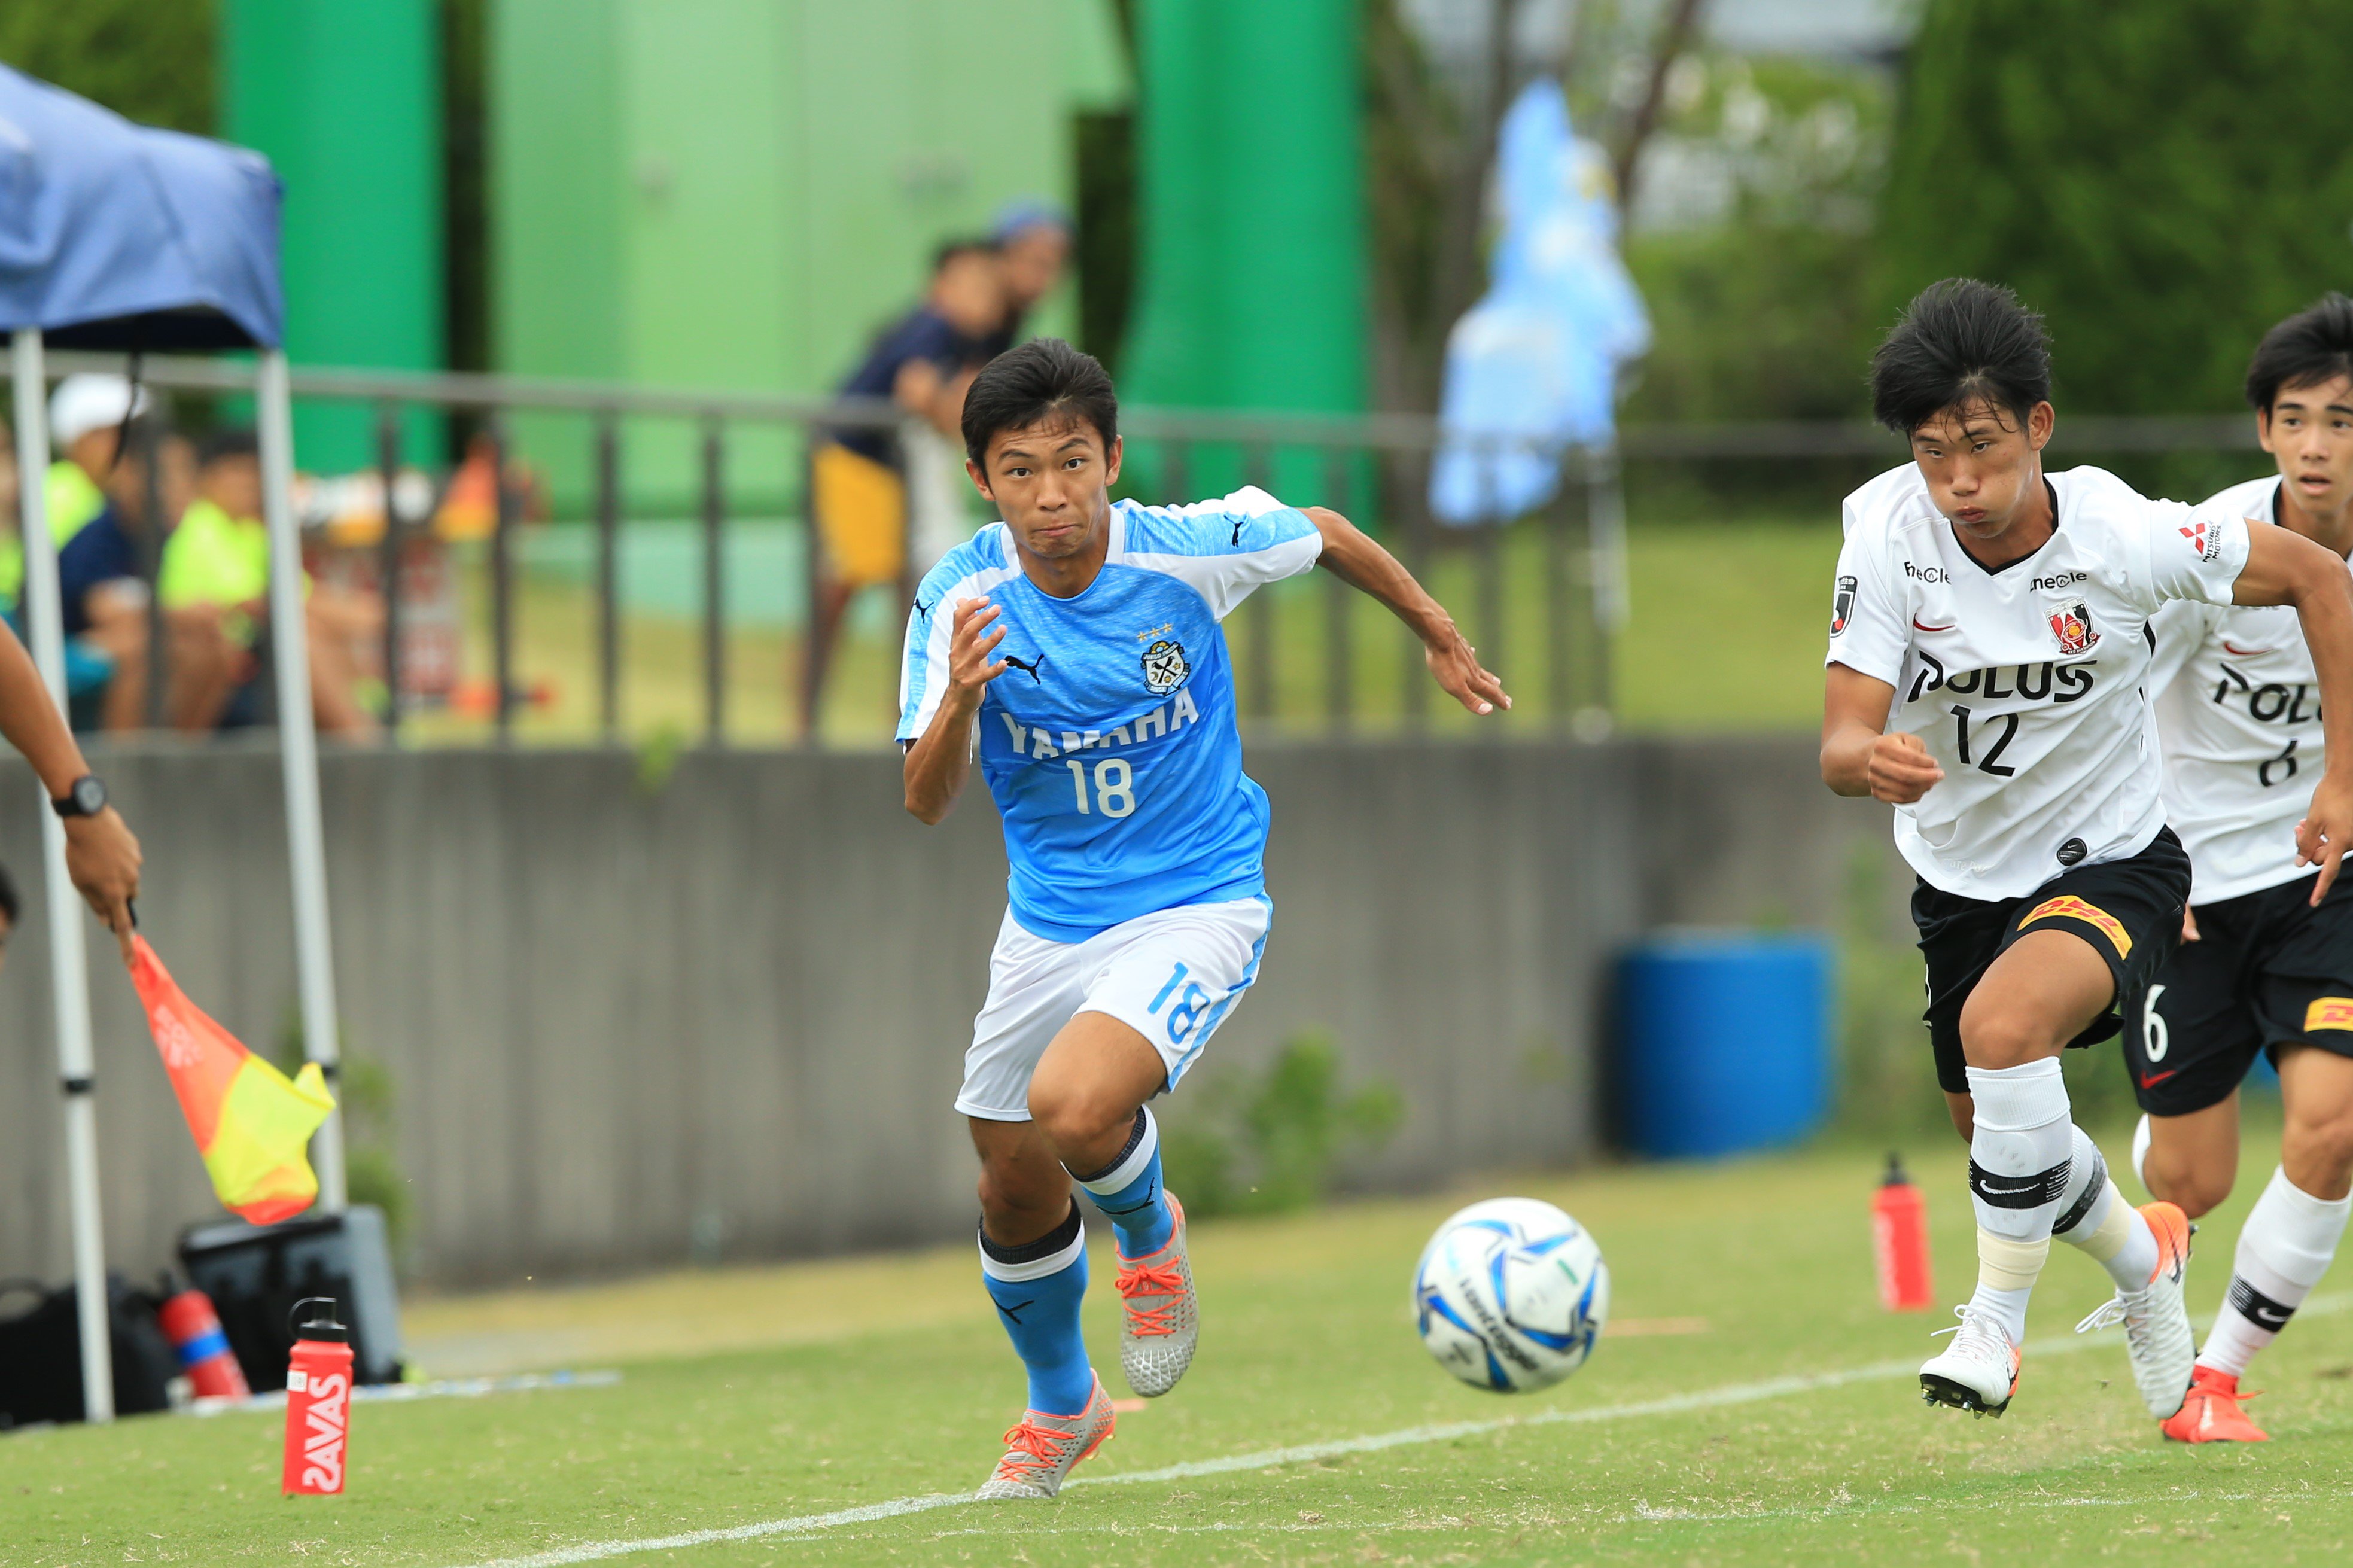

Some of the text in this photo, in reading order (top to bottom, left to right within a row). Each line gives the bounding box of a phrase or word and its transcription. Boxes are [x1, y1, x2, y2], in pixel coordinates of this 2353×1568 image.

[2212, 525, 2221, 559] MOTORS
[1907, 650, 2098, 703] POLUS
[2214, 662, 2323, 724] POL
[1950, 705, 2019, 777] 12
[1066, 758, 1136, 818] 18
[2031, 899, 2118, 939] DHL
[1147, 961, 1211, 1045] 18
[2143, 984, 2168, 1063] 6
[302, 1373, 347, 1492] SAVAS
